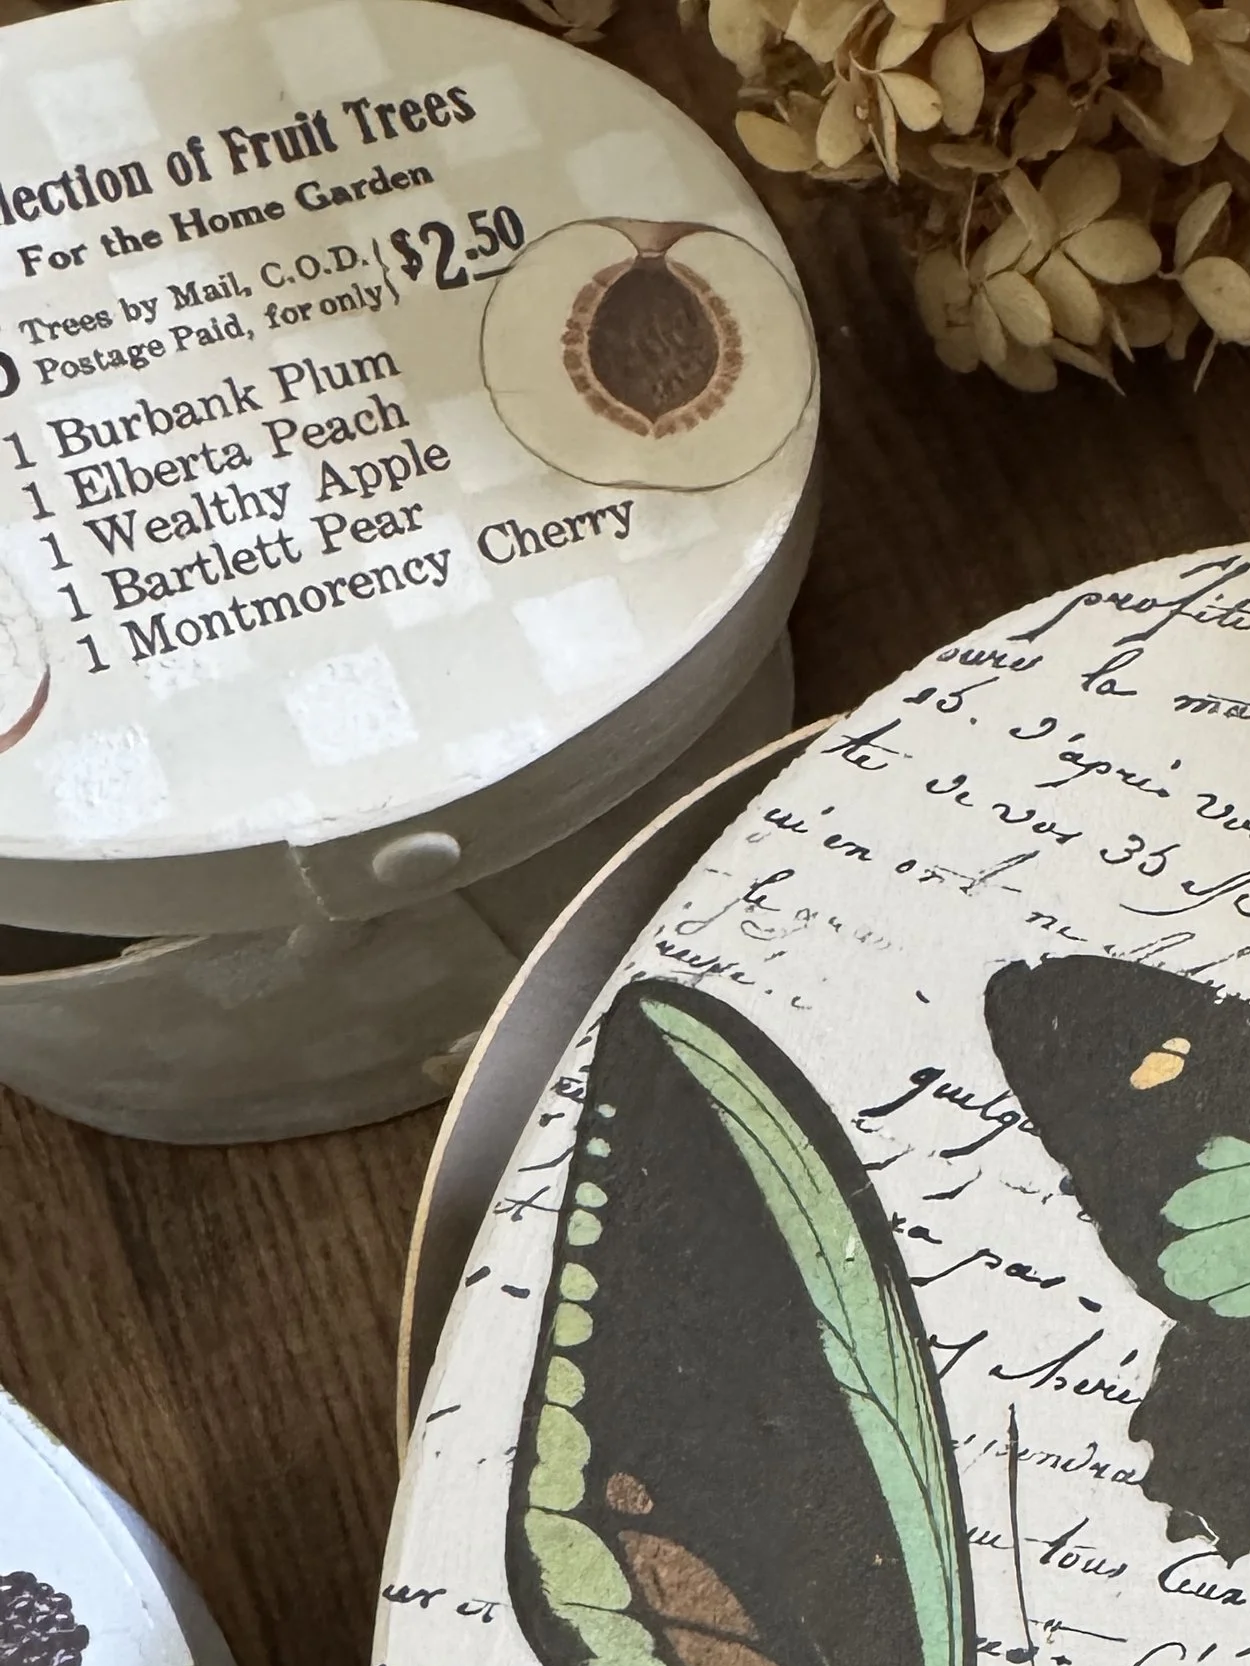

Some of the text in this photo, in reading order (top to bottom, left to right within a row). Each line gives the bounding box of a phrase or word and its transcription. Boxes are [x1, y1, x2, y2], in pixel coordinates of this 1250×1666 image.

[166, 135, 213, 188] of
[218, 108, 339, 177] Fruit
[343, 83, 478, 145] Trees
[17, 161, 436, 277] For the Home Garden
[388, 204, 526, 291] $2.50
[18, 243, 371, 345] Trees by Mail, C.O.D.
[33, 337, 167, 385] Postage
[168, 312, 256, 353] Paid,
[263, 300, 313, 331] for
[317, 279, 383, 317] only
[2, 346, 403, 471] 1 Burbank Plum
[20, 394, 412, 523] 1 Elberta Peach
[39, 438, 453, 572] 1 Wealthy Apple
[56, 498, 426, 624] 1 Bartlett Pear
[75, 499, 637, 676] 1 Montmorency Cherry
